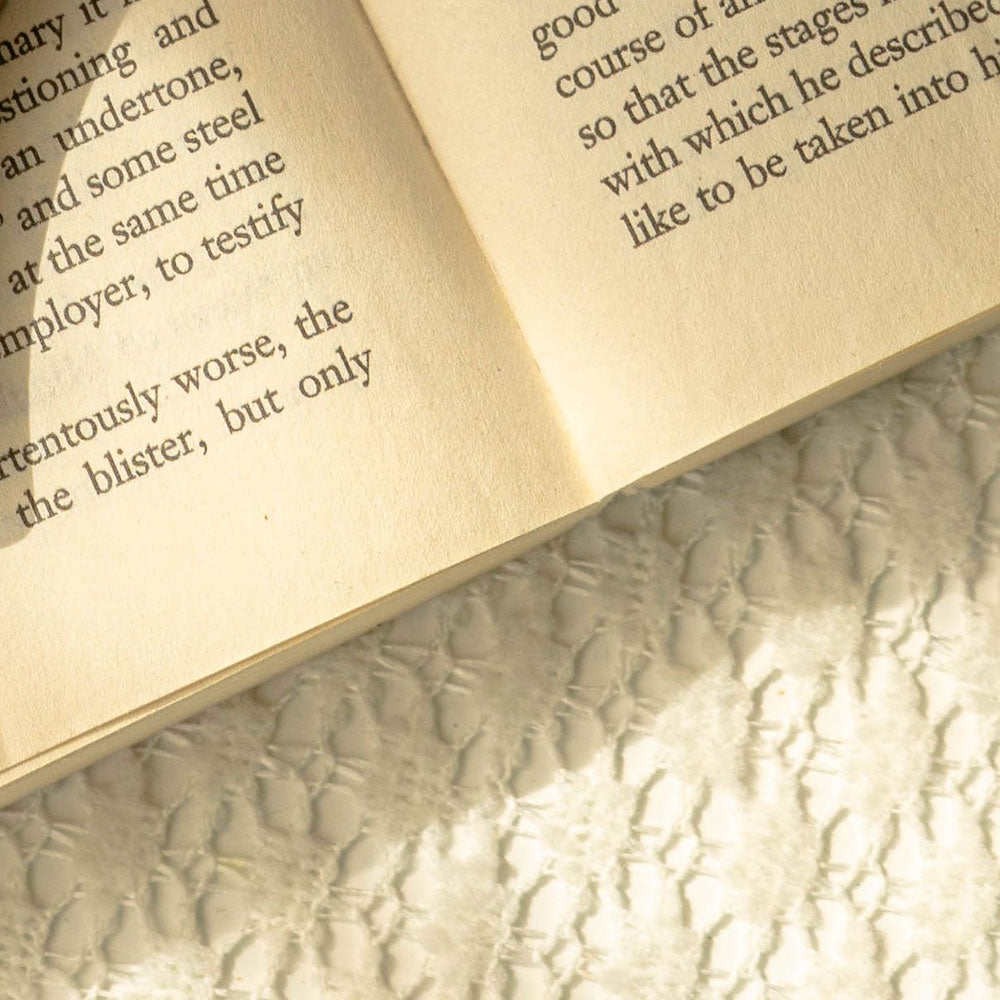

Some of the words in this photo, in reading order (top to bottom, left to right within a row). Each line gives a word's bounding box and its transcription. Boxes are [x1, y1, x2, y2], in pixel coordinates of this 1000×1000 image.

[554, 28, 666, 99] course
[15, 172, 82, 232] and
[85, 140, 177, 199] some
[182, 87, 265, 154] steel
[618, 201, 691, 249] like
[694, 179, 735, 213] to
[734, 152, 788, 190] be
[792, 104, 894, 165] taken
[892, 69, 970, 118] into
[154, 251, 194, 282] to
[199, 191, 304, 261] testify
[14, 486, 74, 529] the
[80, 428, 208, 496] blister,
[214, 388, 285, 435] but
[297, 344, 372, 399] only
